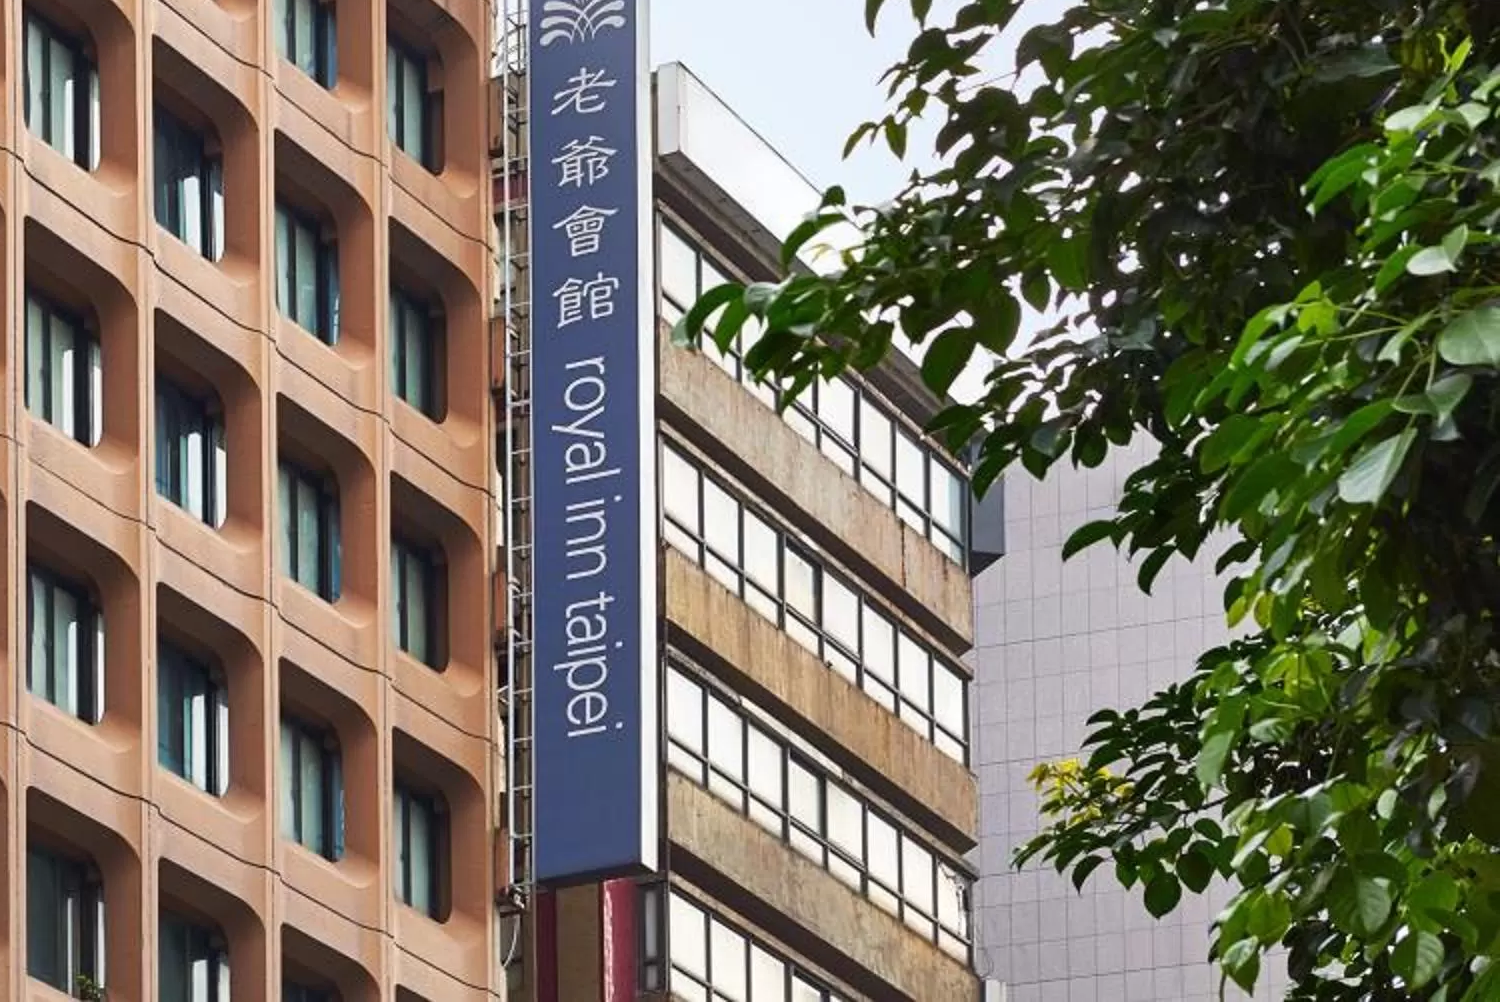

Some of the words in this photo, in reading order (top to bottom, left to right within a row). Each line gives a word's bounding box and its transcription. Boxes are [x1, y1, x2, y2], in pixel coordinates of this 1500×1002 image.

[551, 66, 620, 329] 老爺會館
[551, 355, 622, 485] royal
[565, 494, 622, 580] inn
[553, 590, 623, 738] taipei
